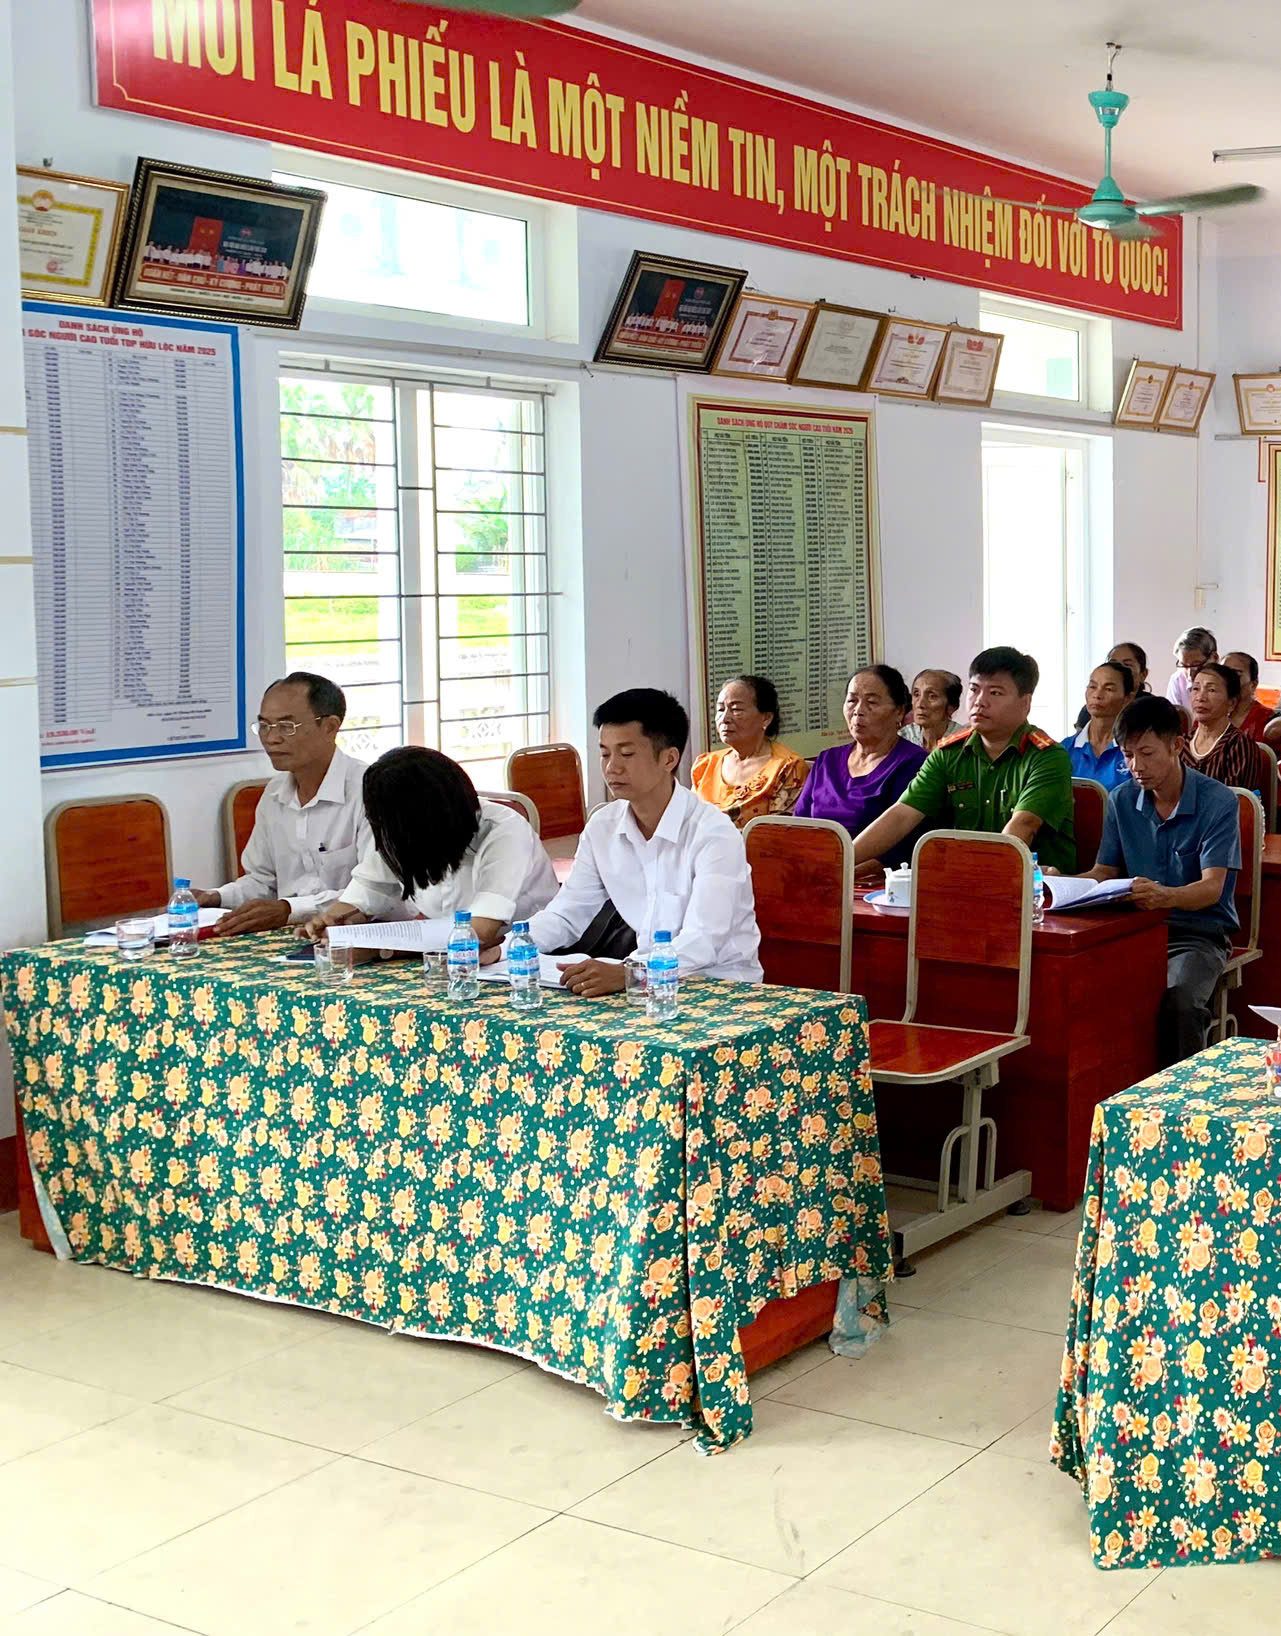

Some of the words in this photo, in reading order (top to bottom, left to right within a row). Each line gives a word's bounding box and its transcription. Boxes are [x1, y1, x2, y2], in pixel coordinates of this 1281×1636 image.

[346, 19, 475, 133] PHIẾU
[489, 50, 537, 149] LÀ
[548, 72, 625, 181] MỘT
[636, 89, 719, 191] NIỀM
[728, 127, 784, 214] TIN,
[793, 139, 851, 232] MỘT
[858, 159, 936, 242] TRÁCH
[943, 185, 1013, 268] NHIỆM
[1019, 194, 1052, 269] ĐỐI
[1057, 211, 1087, 278] VỚI
[59, 320, 83, 331] DANH
[86, 322, 110, 333] SÁCH
